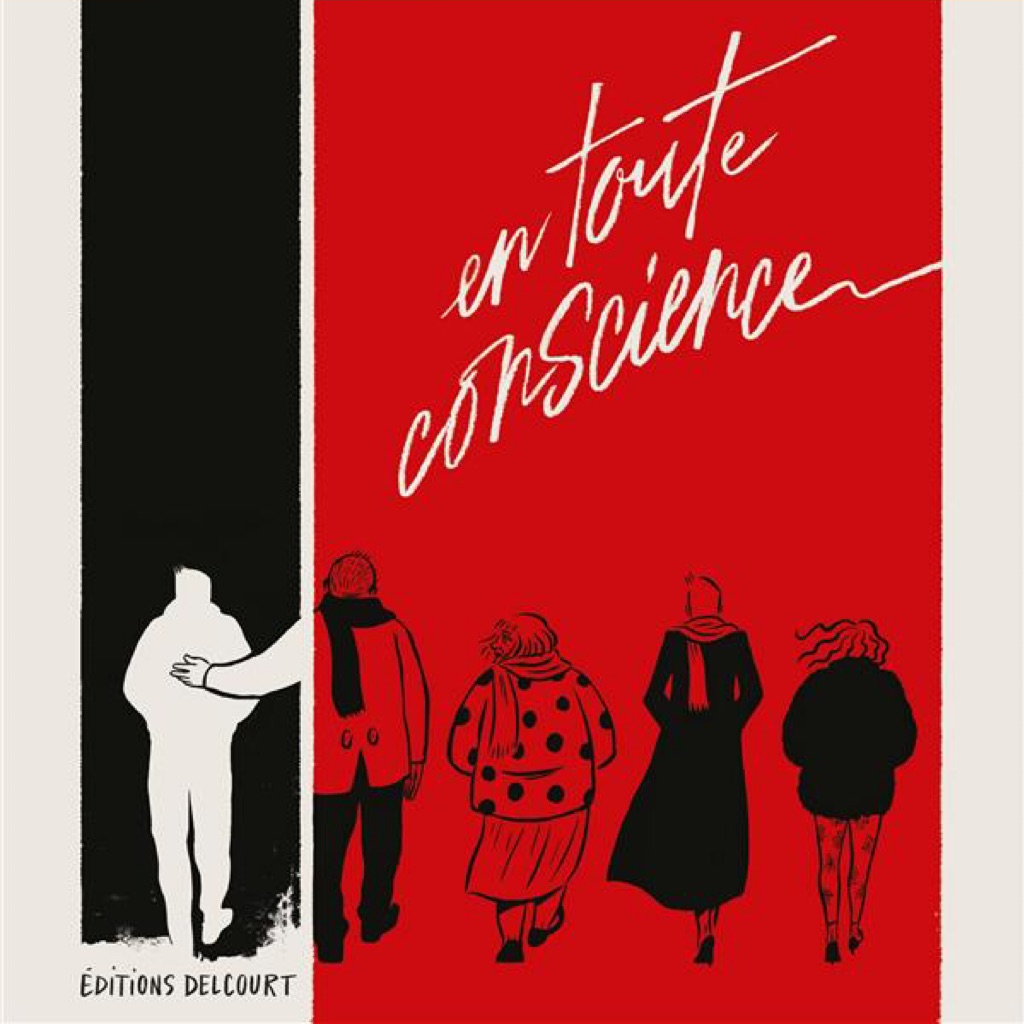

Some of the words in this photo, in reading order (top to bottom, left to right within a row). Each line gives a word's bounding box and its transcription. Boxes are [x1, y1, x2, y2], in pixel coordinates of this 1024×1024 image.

[442, 212, 552, 318] en
[547, 31, 837, 268] toute
[397, 248, 942, 497] conscience
[184, 973, 298, 998] DELCOURT
